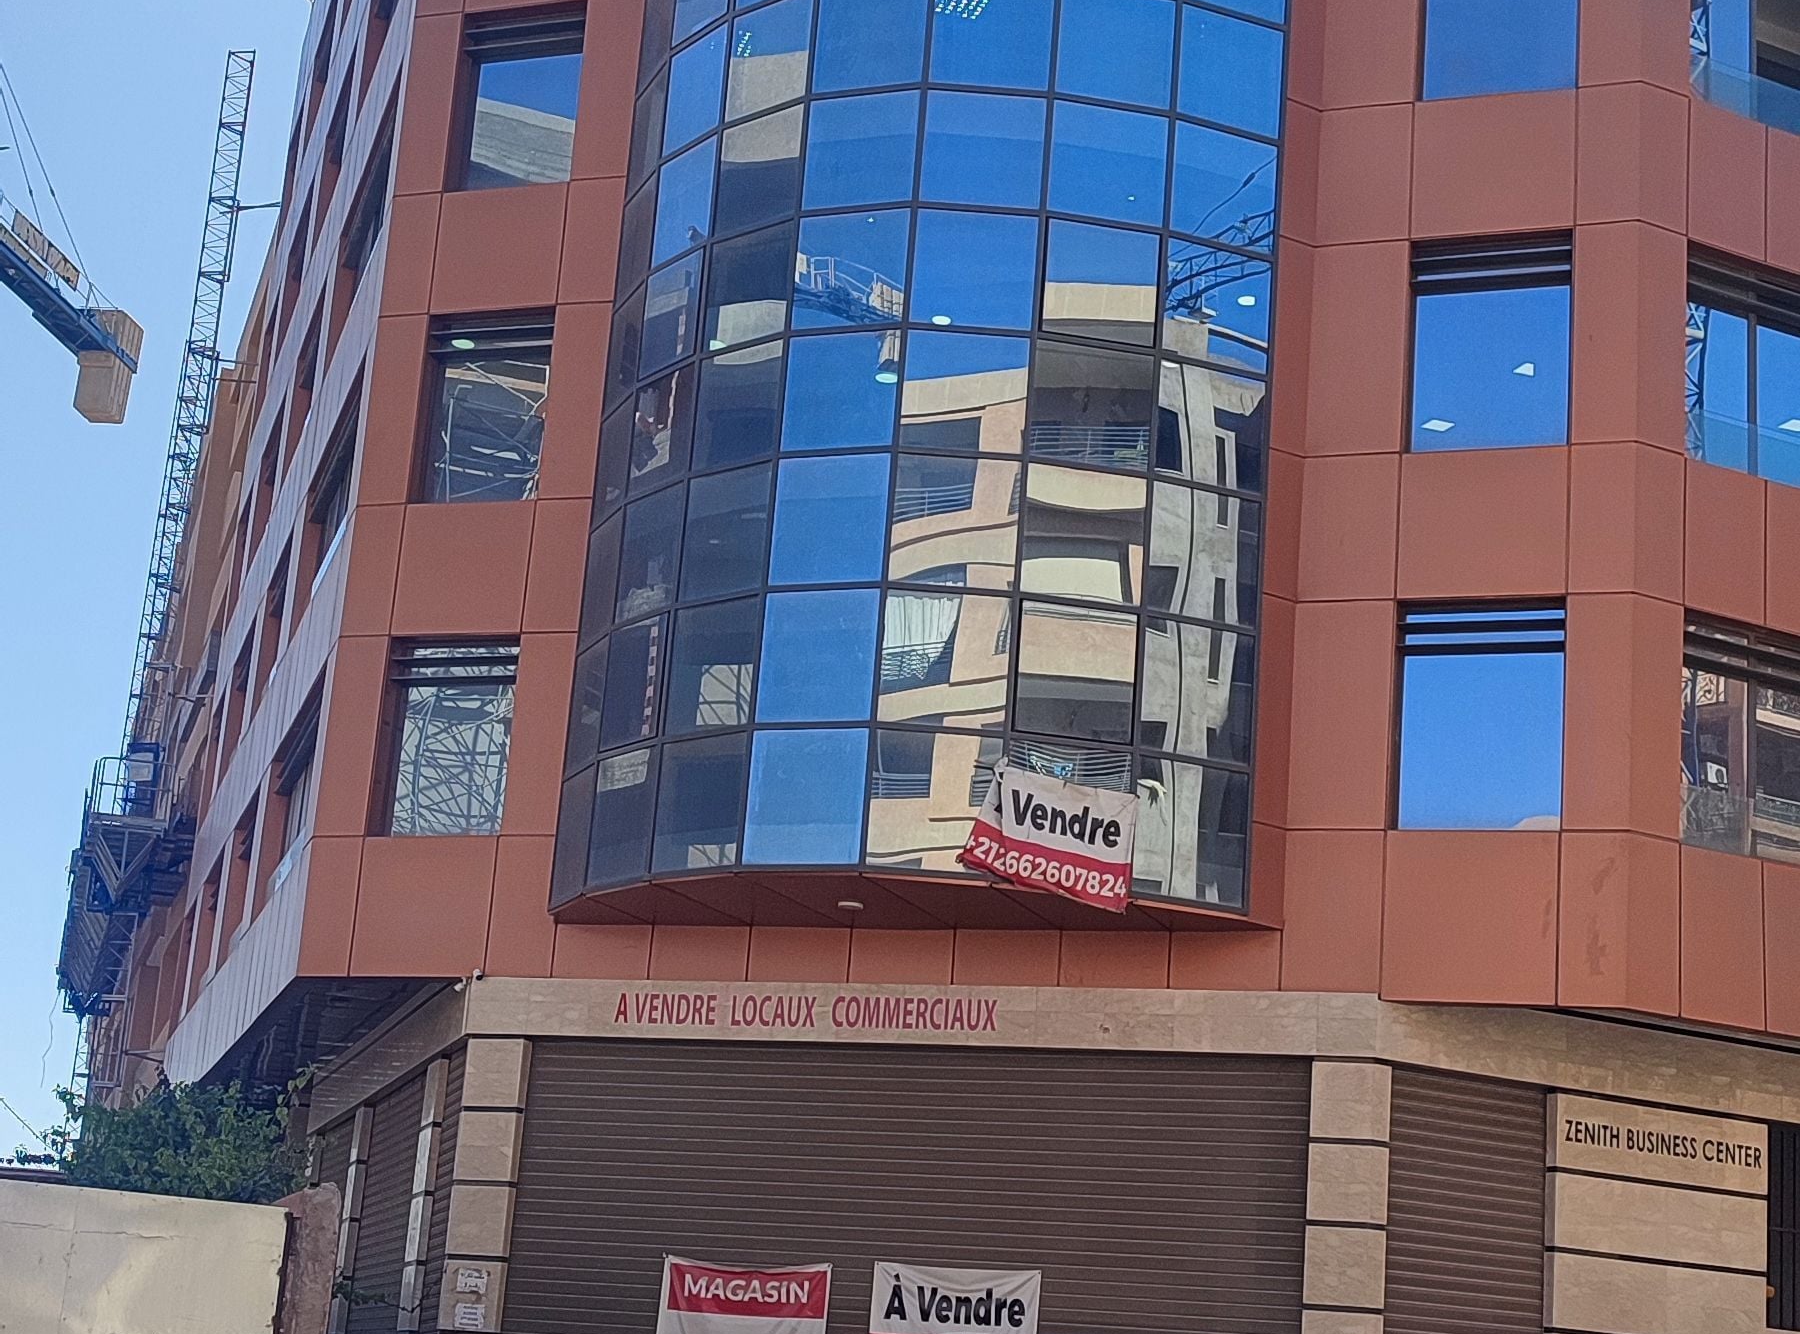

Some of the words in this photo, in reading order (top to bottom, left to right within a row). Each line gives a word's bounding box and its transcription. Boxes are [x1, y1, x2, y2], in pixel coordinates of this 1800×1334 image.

[1011, 789, 1121, 848] Vendre
[614, 992, 628, 1024] A
[635, 993, 718, 1025] VENDRE
[730, 995, 817, 1028] LOCAUX
[831, 996, 998, 1031] COMMERCIAUX
[1564, 1119, 1620, 1149] ZENITH
[1626, 1128, 1698, 1159] BUSINESS
[1702, 1139, 1762, 1169] CENTER
[683, 1273, 810, 1304] MAGASIN
[883, 1272, 907, 1321] À
[916, 1285, 1026, 1328] Vendre
